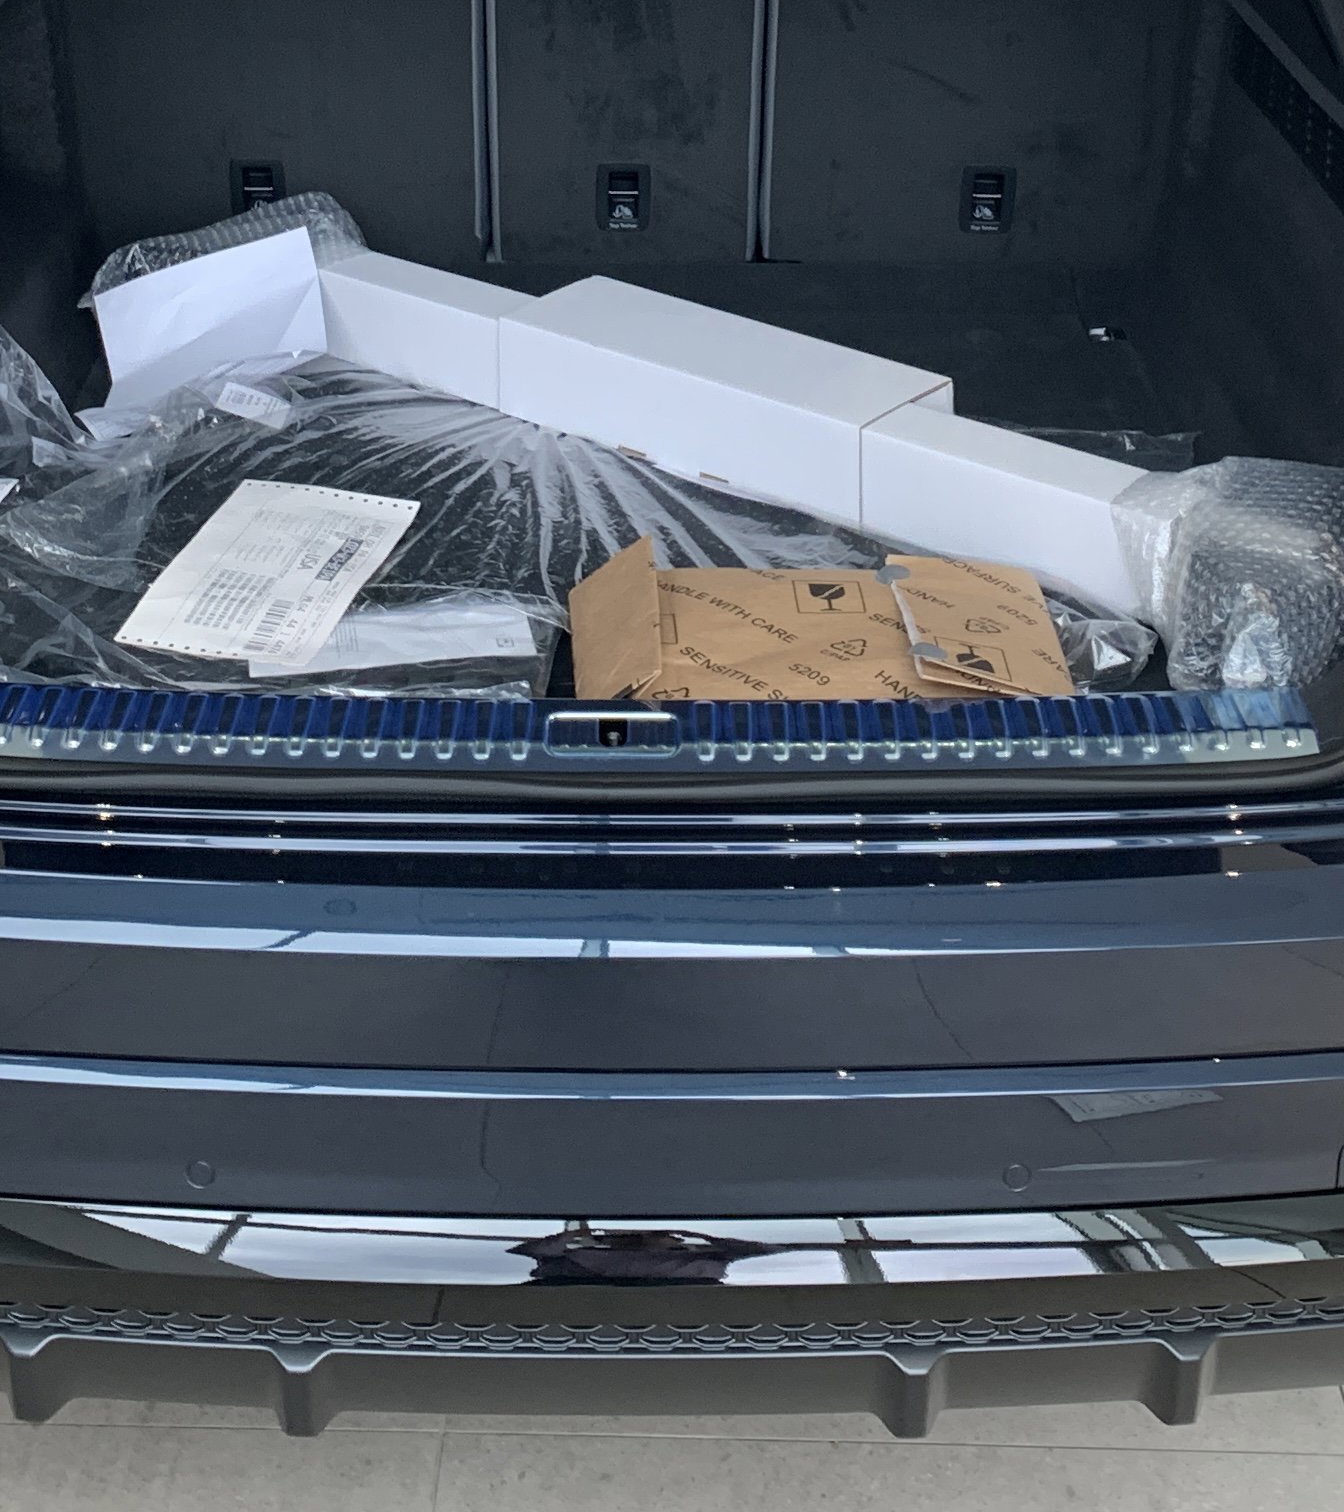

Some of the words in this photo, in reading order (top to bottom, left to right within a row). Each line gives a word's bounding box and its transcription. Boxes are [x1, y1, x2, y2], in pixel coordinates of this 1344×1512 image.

[709, 597, 752, 620] WITH
[751, 617, 799, 644] CARE
[997, 604, 1038, 626] 5209
[679, 646, 770, 692] SENSITIVE
[788, 663, 831, 686] 5209
